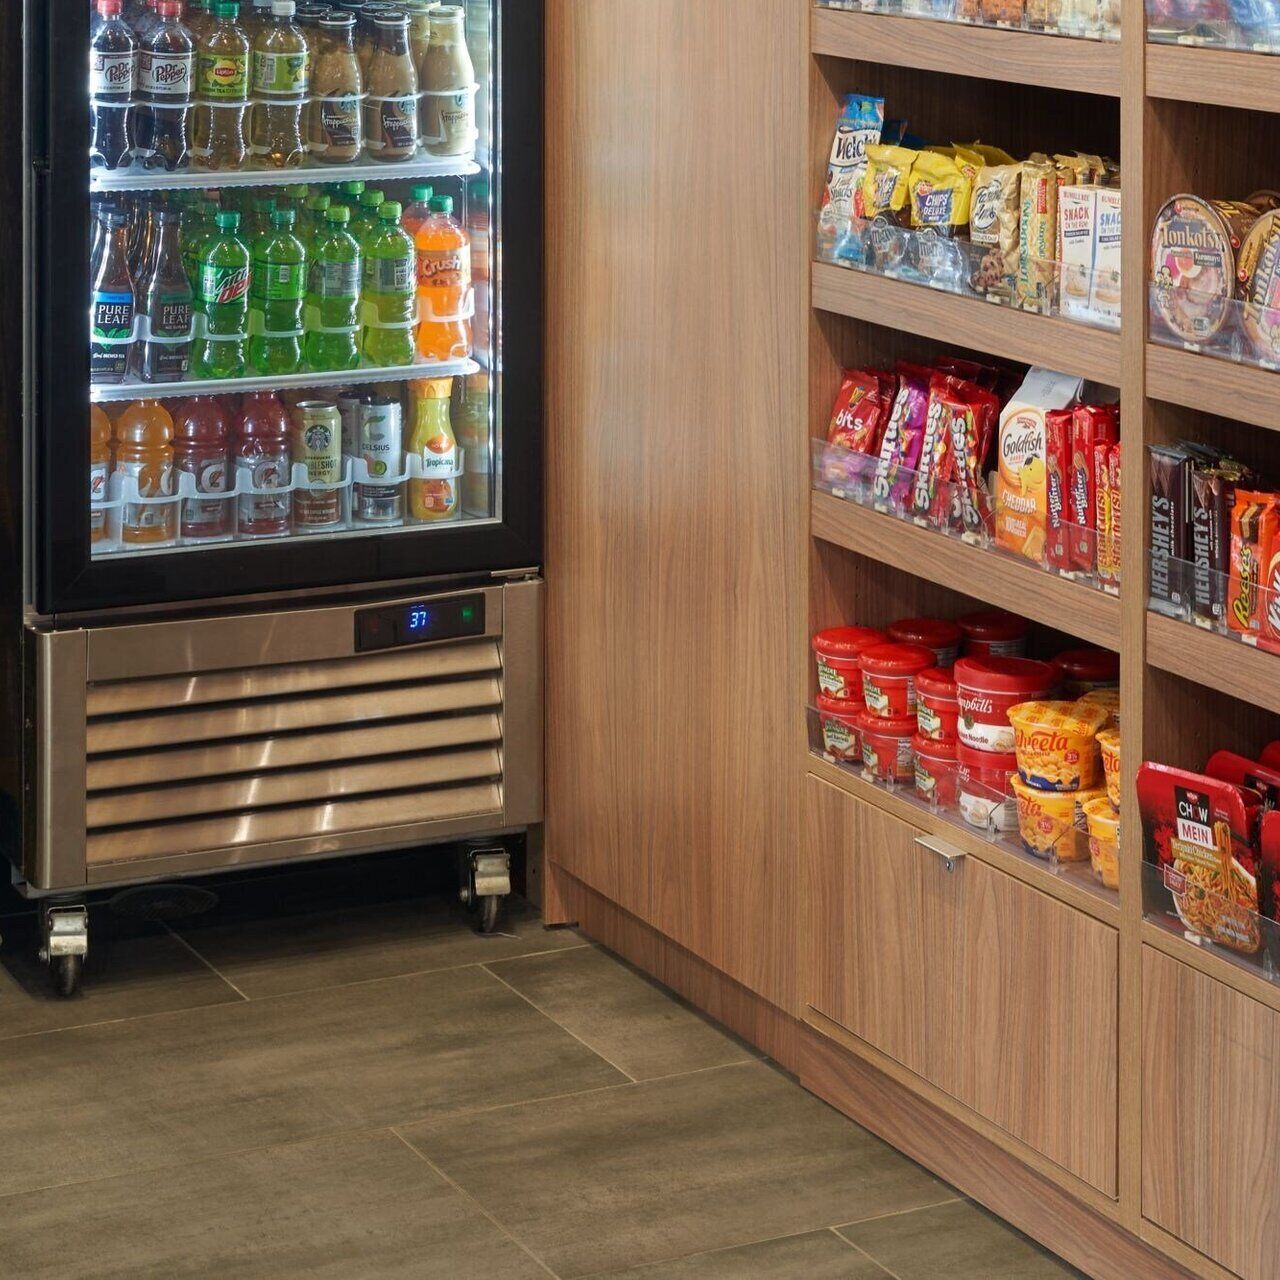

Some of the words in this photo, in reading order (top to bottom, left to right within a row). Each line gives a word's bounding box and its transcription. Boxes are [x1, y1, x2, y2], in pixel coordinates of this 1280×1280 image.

[156, 66, 185, 82] Pepper
[165, 64, 177, 72] Dr
[926, 195, 948, 206] CHIPS
[923, 206, 946, 215] DELUXE
[1064, 207, 1089, 220] SNACK
[1101, 212, 1120, 225] SNAC
[423, 255, 462, 277] Crush
[99, 305, 130, 314] PURE
[163, 305, 191, 314] PURE
[163, 315, 190, 325] LEAF
[836, 409, 864, 431] bits
[1003, 430, 1043, 458] Goldfish
[426, 458, 453, 468] Tropicana
[1050, 474, 1062, 511] Butter
[1077, 471, 1088, 507] Butter
[1003, 491, 1037, 513] CHEDDAR
[1048, 491, 1060, 528] Nutter
[1075, 487, 1086, 525] Nutter
[1151, 496, 1169, 597] HERSHEY'S
[1194, 506, 1210, 604] HERSHEY'S
[410, 611, 427, 628] 37
[1183, 823, 1208, 844] MEIN
